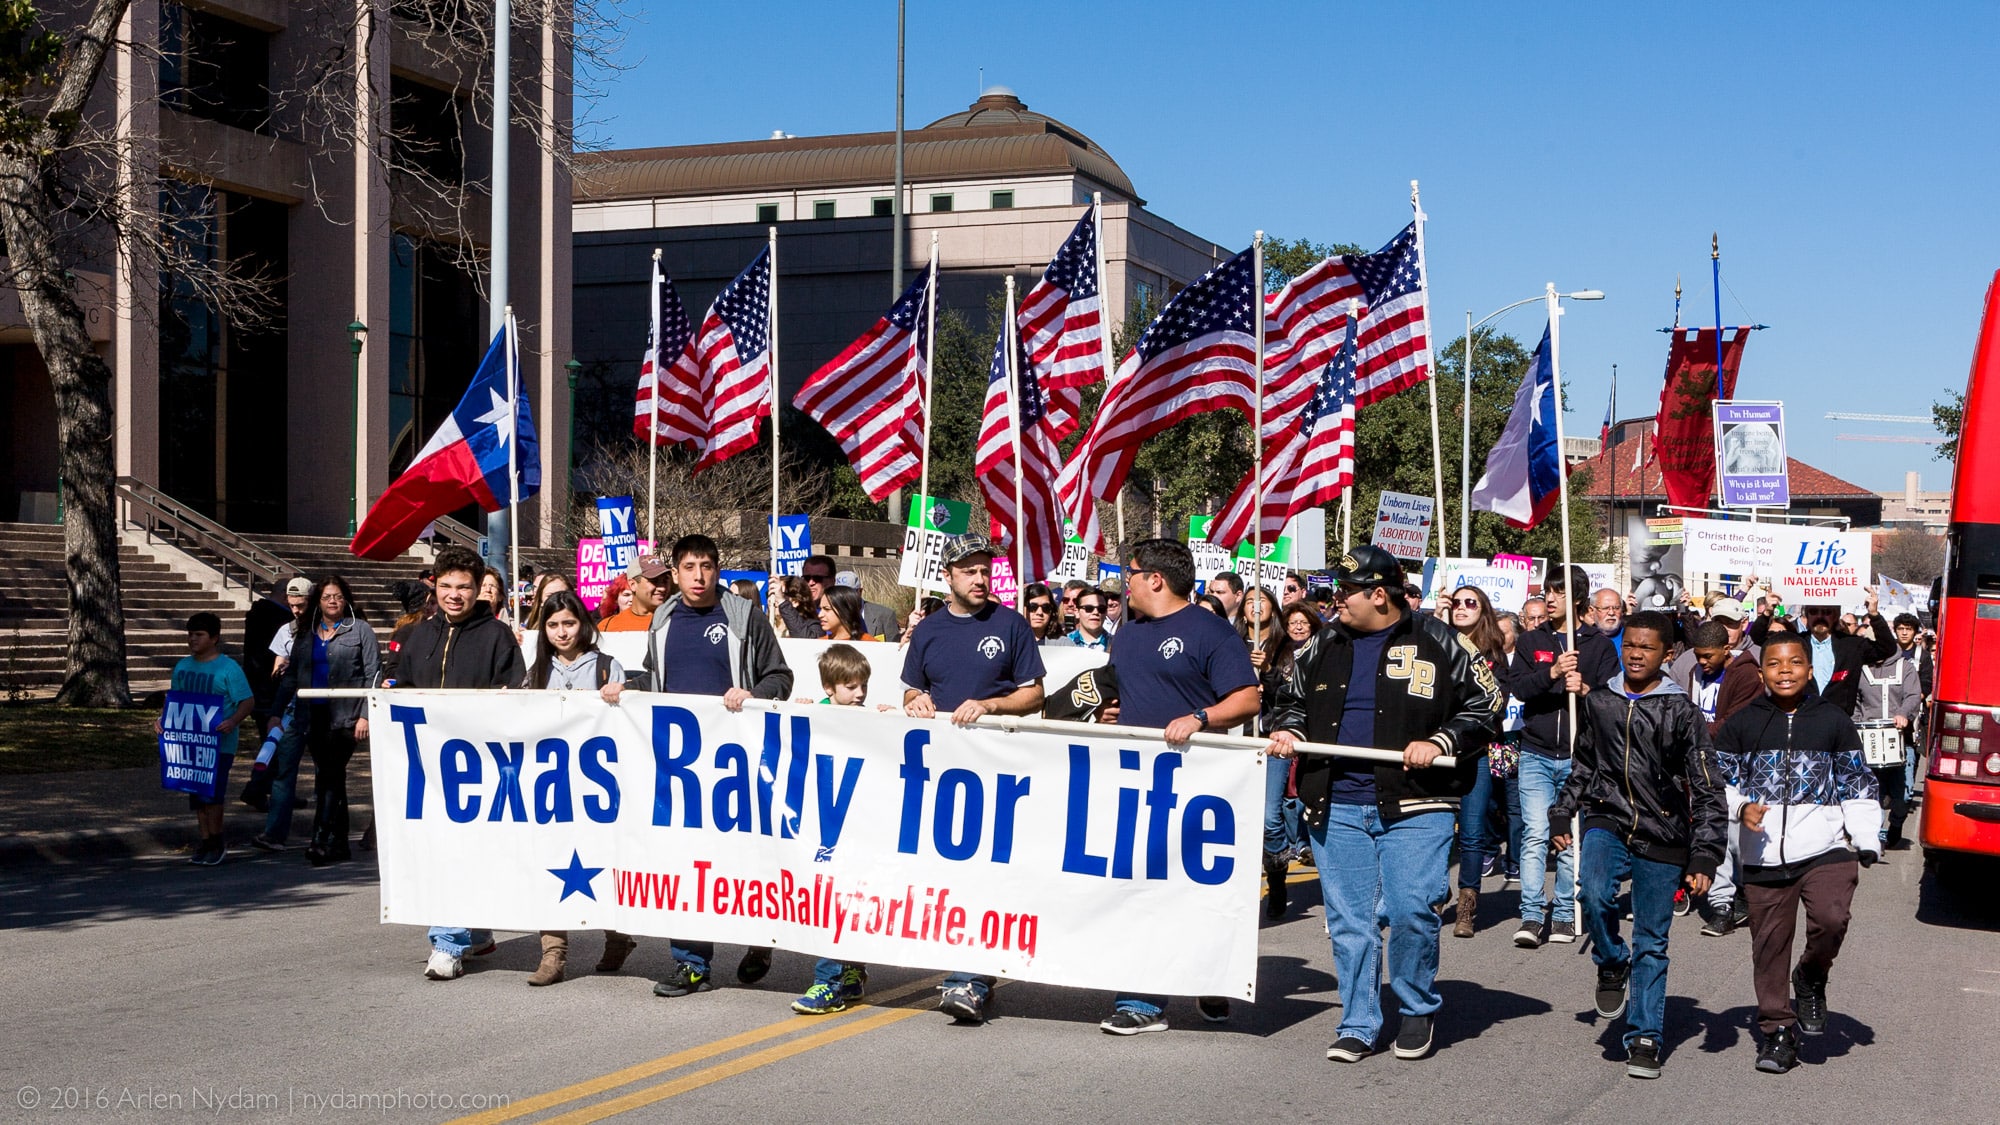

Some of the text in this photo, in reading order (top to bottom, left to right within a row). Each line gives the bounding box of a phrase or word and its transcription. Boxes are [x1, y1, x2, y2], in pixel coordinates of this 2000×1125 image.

[1743, 410, 1771, 419] Human
[1383, 495, 1431, 512] Unborn Lives
[1745, 492, 1757, 501] kill
[1391, 512, 1419, 526] Matter!
[1379, 527, 1424, 542] ABORTION
[1697, 531, 1728, 541] Christ
[1729, 532, 1744, 541] the
[1387, 543, 1423, 557] MURDER
[1710, 543, 1750, 553] Catholic
[1205, 557, 1225, 570] VIDA
[1794, 540, 1847, 574] Life
[1237, 560, 1286, 581] DEFENDE
[1796, 566, 1855, 575] the first
[1456, 574, 1514, 589] ABORTION
[1783, 577, 1858, 586] INALIENABLE
[1804, 588, 1838, 597] RIGHT
[164, 701, 220, 732] MY
[163, 731, 218, 746] GENERATION
[164, 743, 217, 769] WILL END
[166, 765, 214, 785] ABORTION
[390, 704, 1236, 886] Texas Rally for Life
